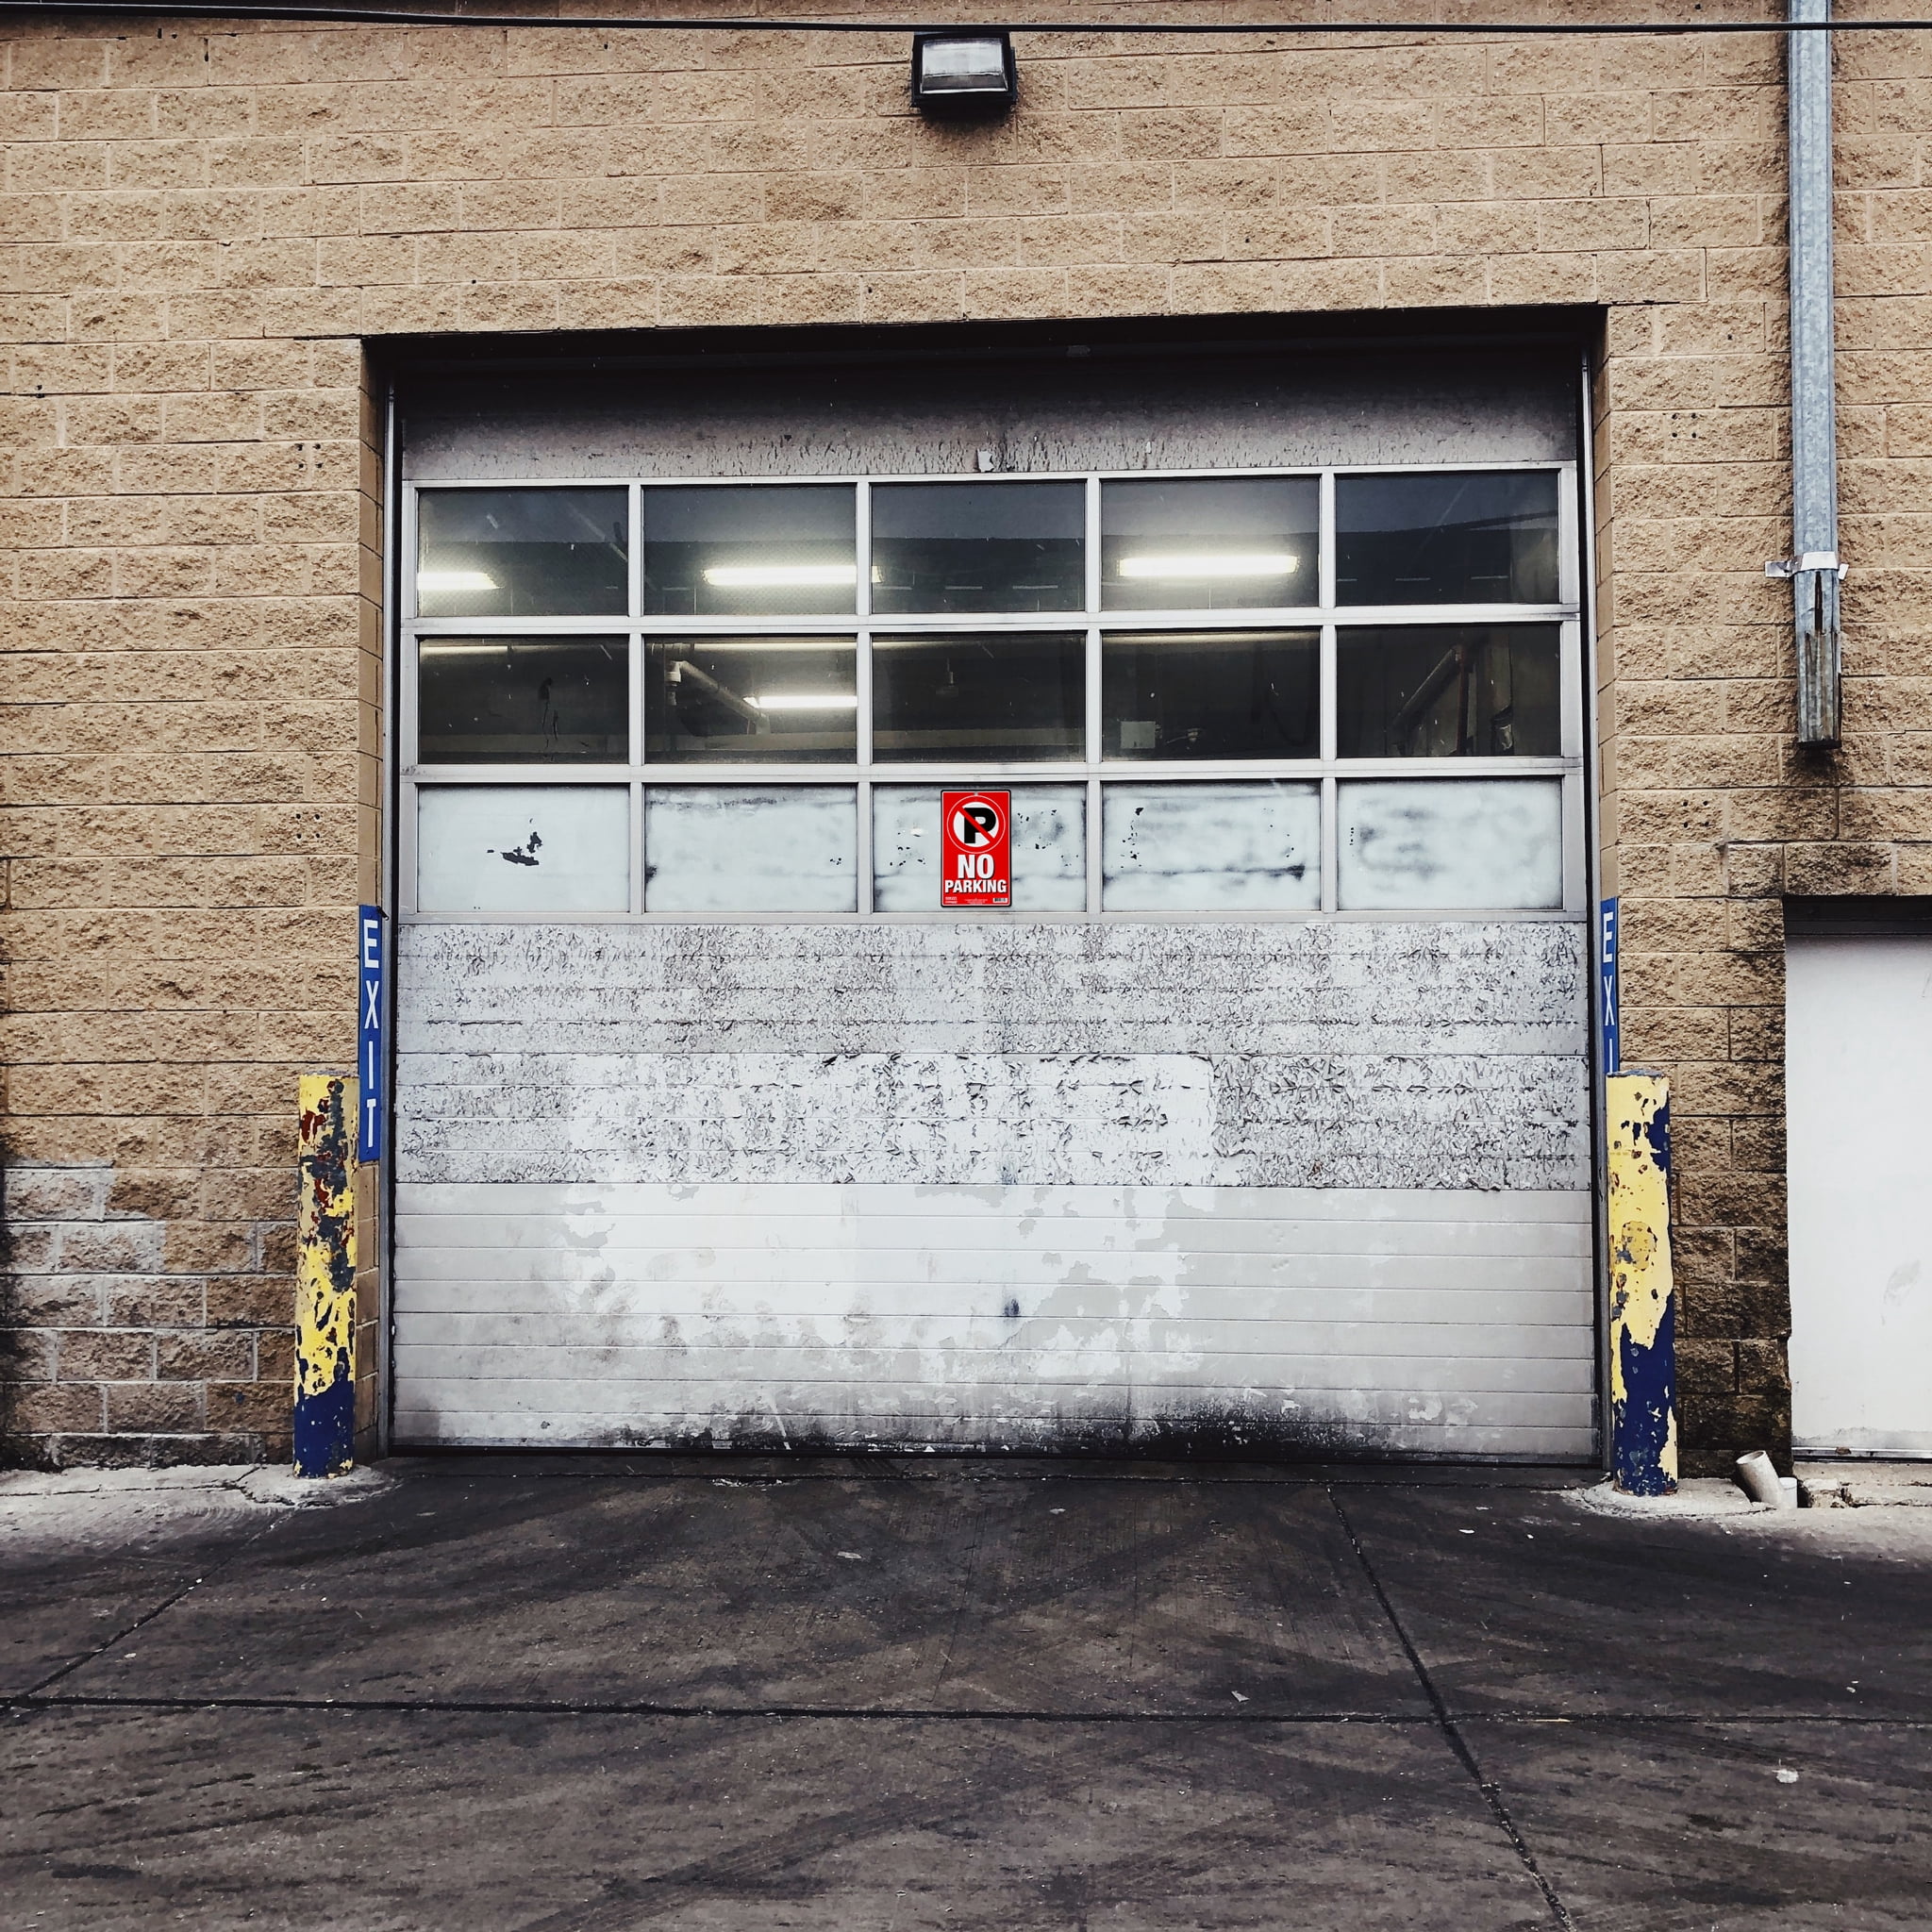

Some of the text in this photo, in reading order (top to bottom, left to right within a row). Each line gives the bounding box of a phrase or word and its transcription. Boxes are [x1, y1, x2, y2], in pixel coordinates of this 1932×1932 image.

[944, 879, 1007, 893] PARKING
[958, 854, 994, 879] NO
[363, 919, 379, 1148] EXIT
[1603, 911, 1615, 1074] EXI
